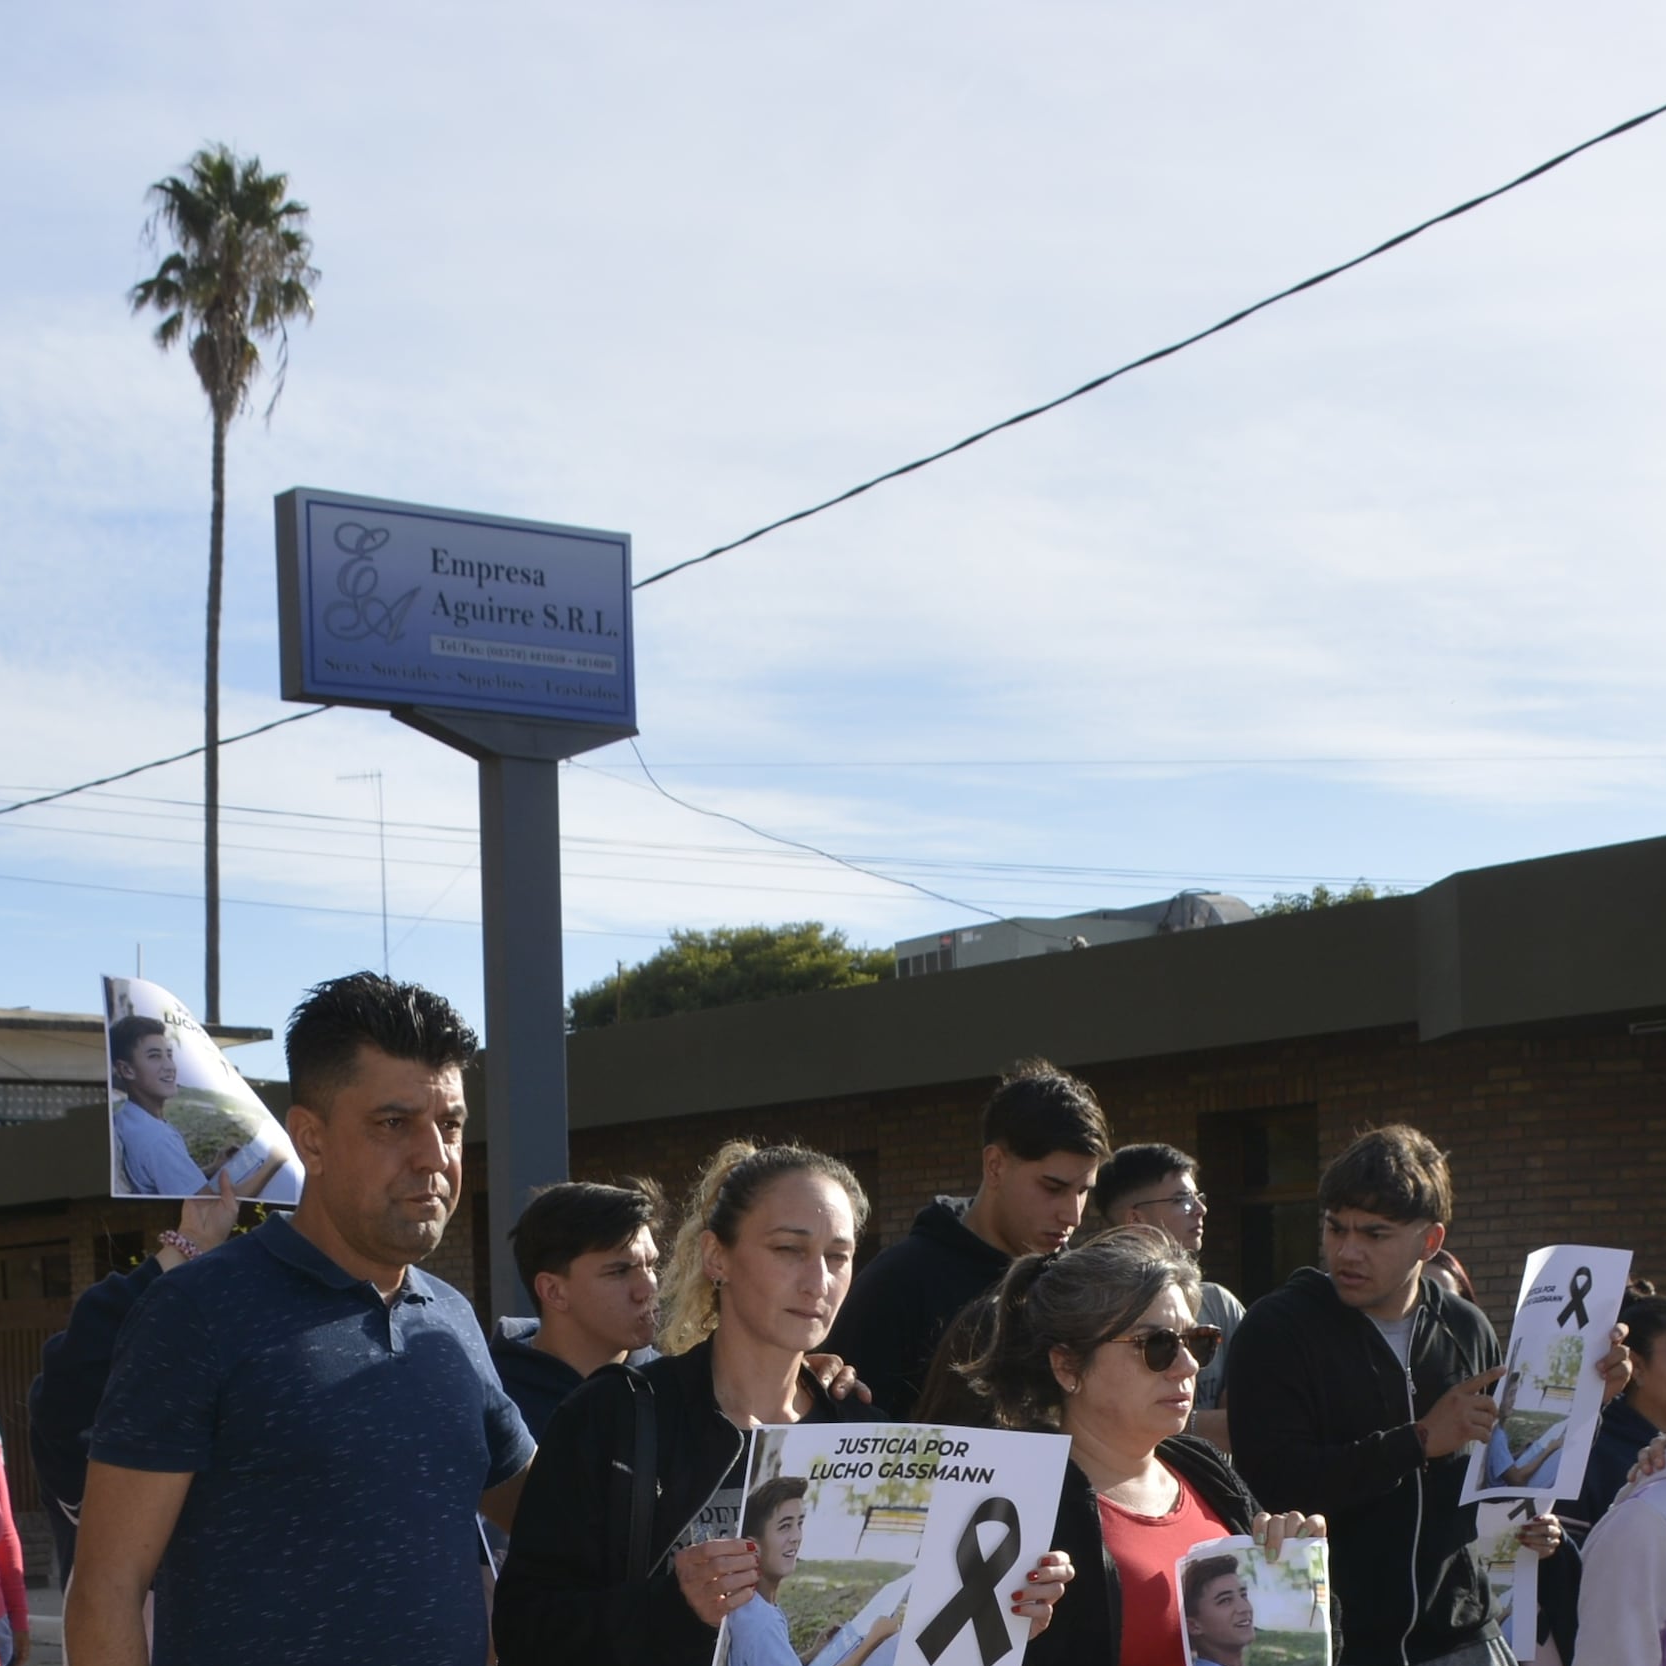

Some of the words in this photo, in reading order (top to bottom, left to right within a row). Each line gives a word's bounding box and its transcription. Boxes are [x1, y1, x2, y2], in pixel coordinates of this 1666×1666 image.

[431, 547, 546, 588] Empresa
[432, 591, 534, 628] Aguirre
[543, 603, 619, 637] S.R.L.
[371, 660, 440, 681] Sociales
[456, 670, 526, 690] Sepelios
[543, 678, 621, 700] Traslados
[834, 1437, 917, 1455] JUSTICIA
[923, 1439, 970, 1458] POR
[809, 1462, 873, 1481] LUCHO
[878, 1462, 995, 1484] GASSMANN
